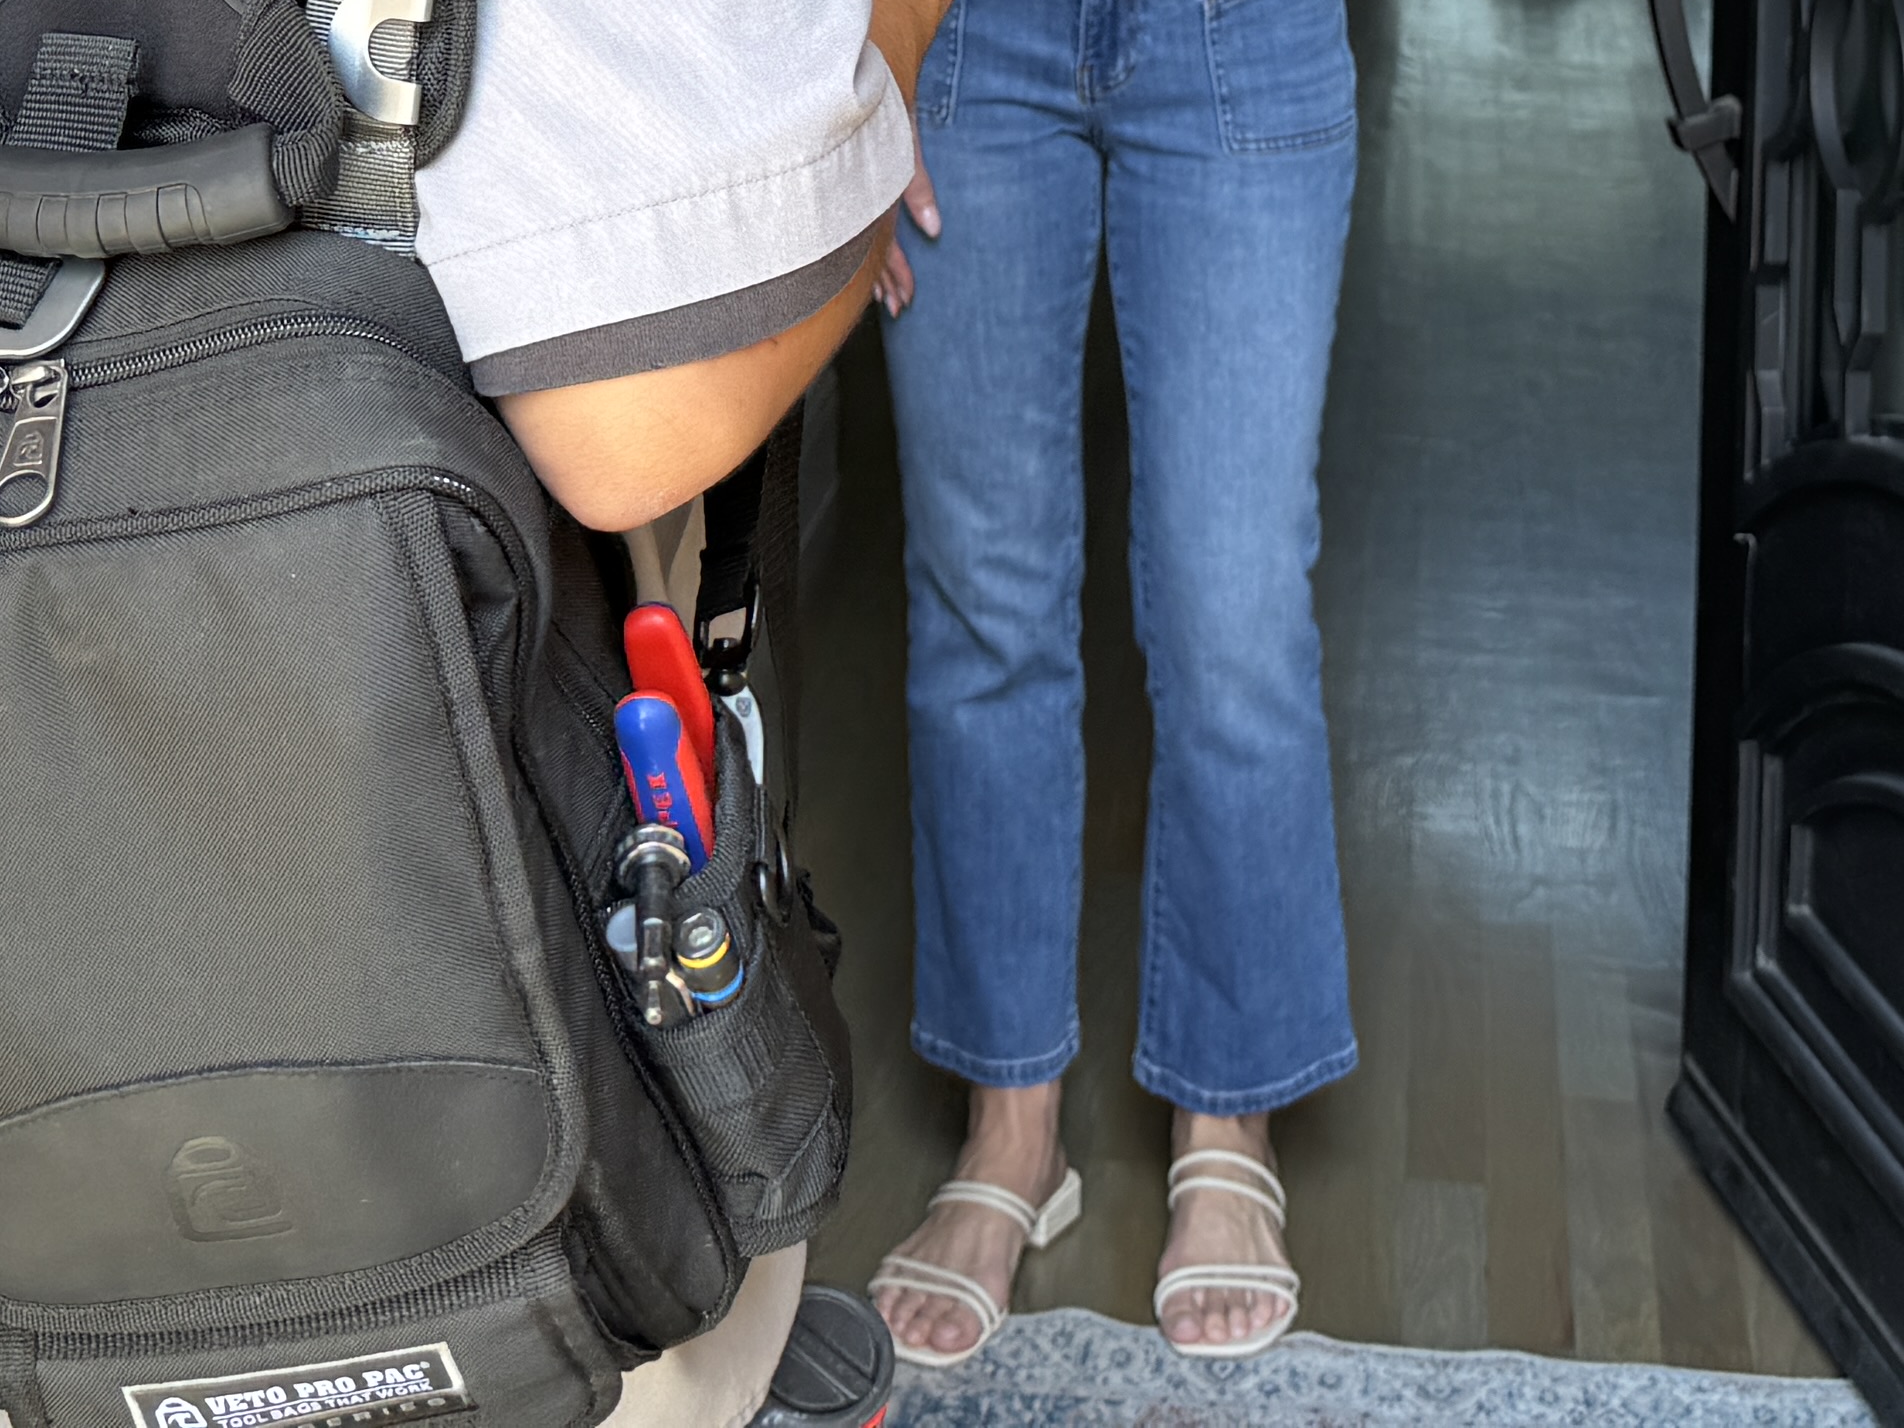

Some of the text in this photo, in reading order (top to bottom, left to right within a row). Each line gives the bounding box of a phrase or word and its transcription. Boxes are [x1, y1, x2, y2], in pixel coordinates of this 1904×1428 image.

[645, 770, 679, 828] PEX
[205, 1386, 287, 1415] VETO
[294, 1376, 356, 1397] PRO
[217, 1382, 434, 1428] TOOL BAGS THAT WORK
